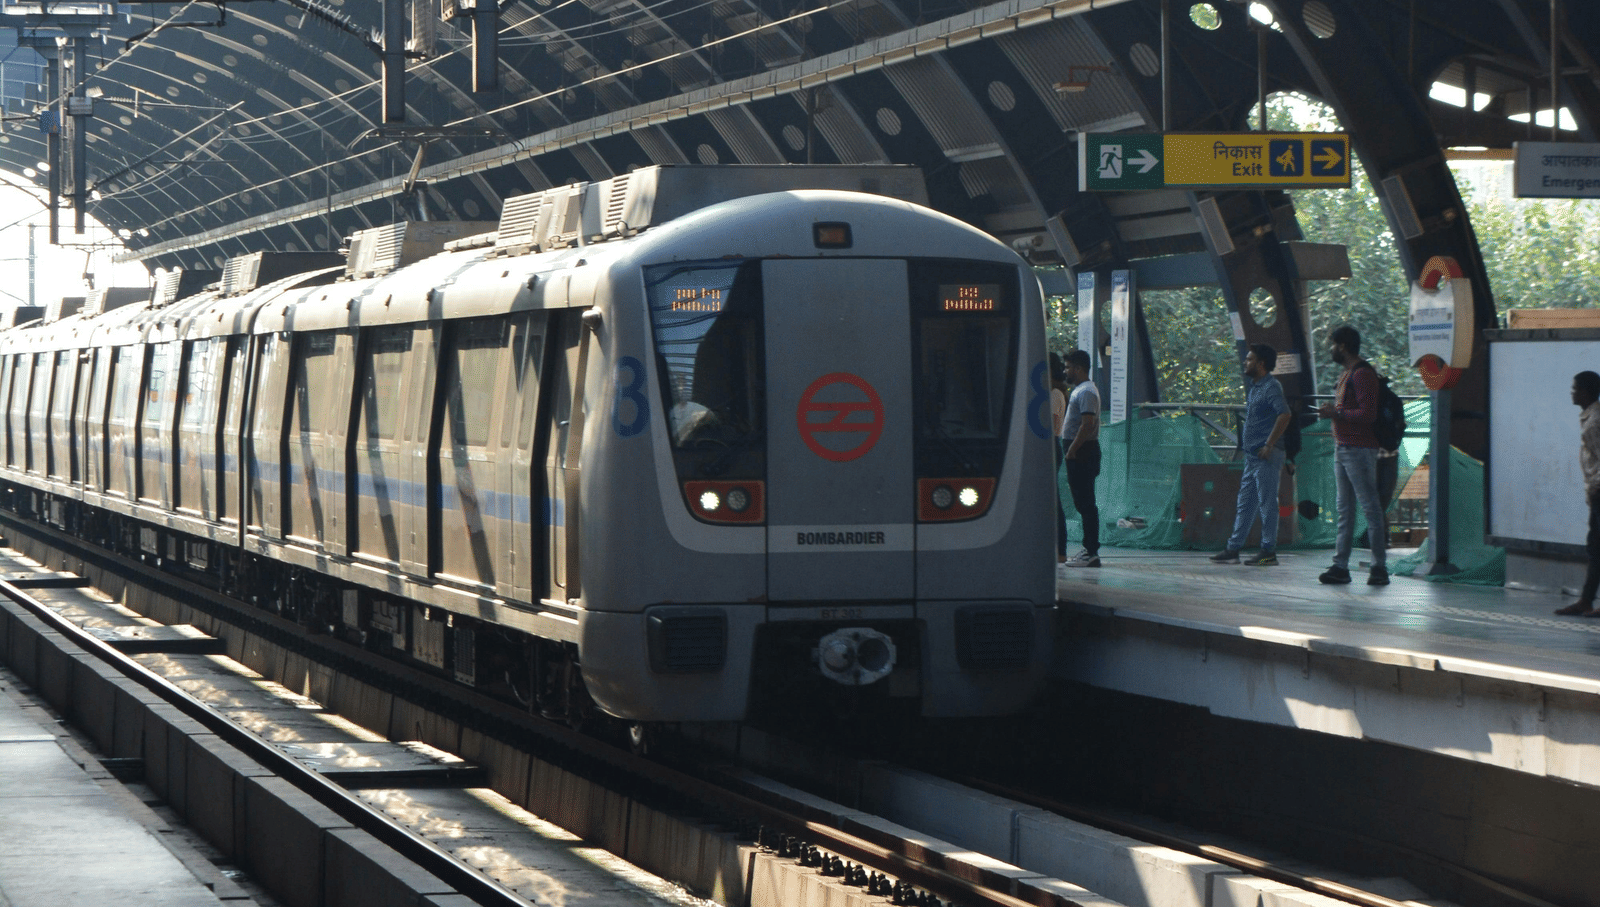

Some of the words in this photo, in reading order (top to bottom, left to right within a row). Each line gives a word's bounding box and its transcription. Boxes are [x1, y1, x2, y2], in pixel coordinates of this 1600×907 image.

[1212, 140, 1263, 160] निकास
[1232, 162, 1263, 176] Exit
[797, 532, 885, 545] BOMBARDIER
